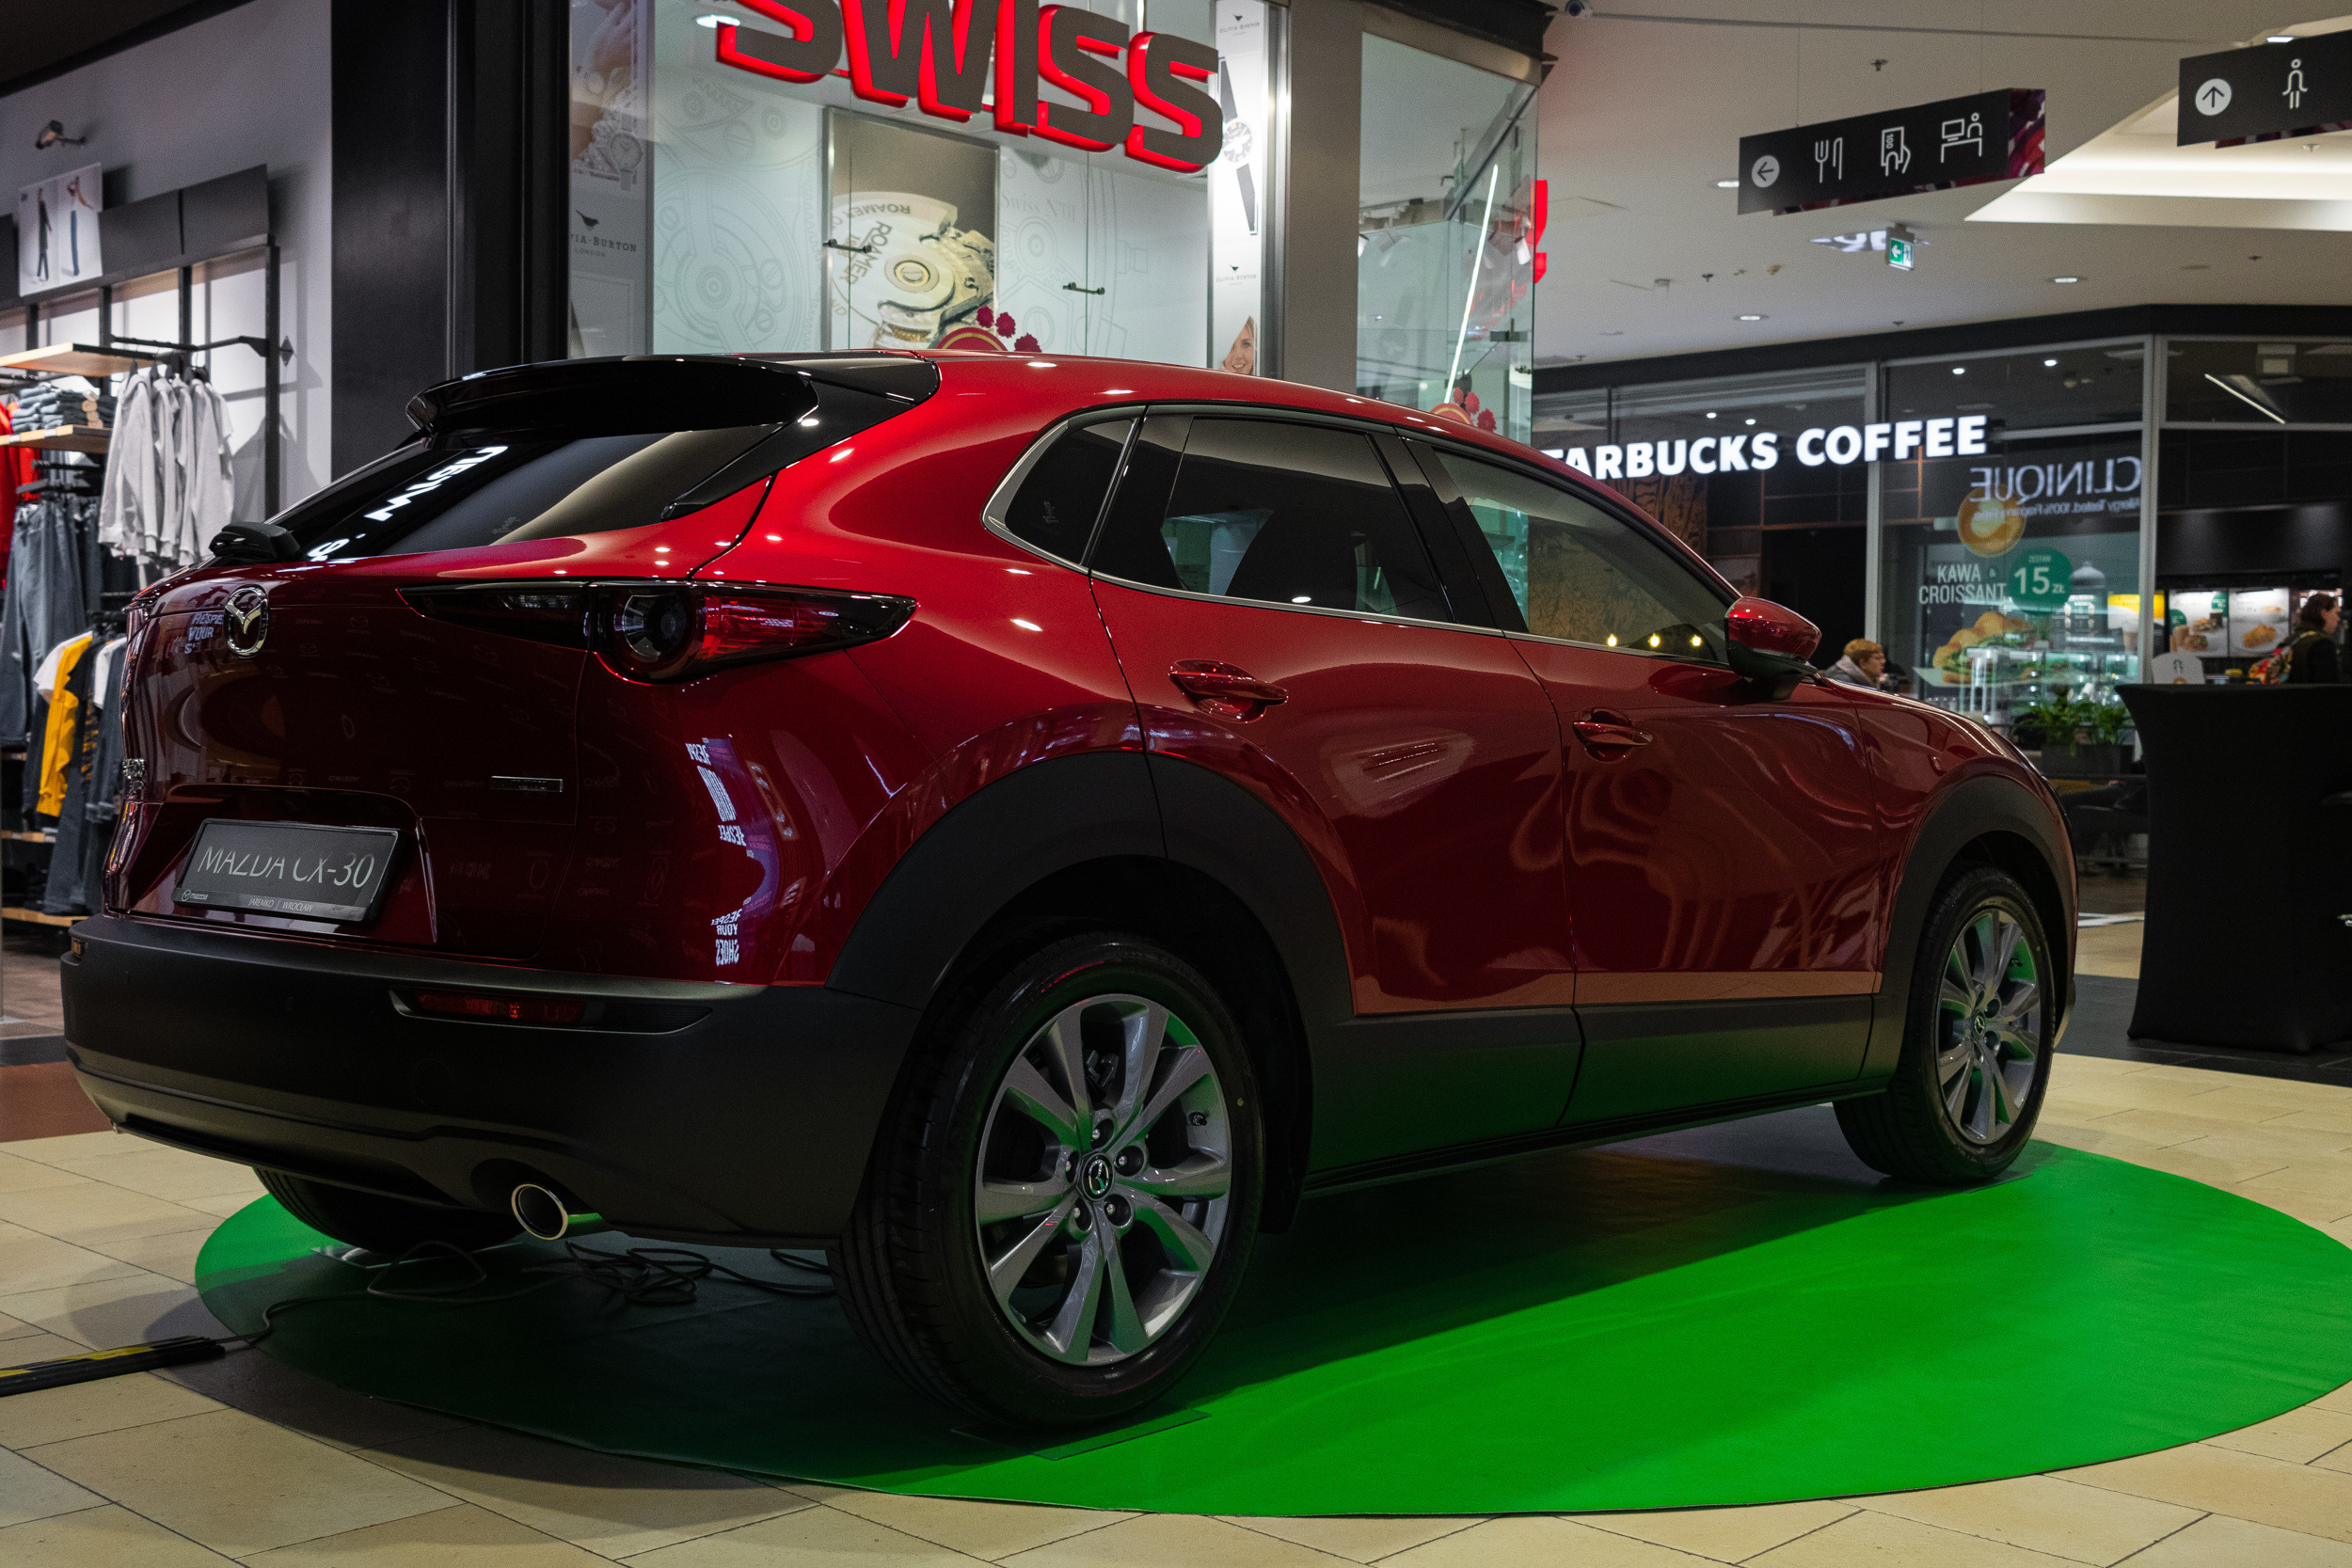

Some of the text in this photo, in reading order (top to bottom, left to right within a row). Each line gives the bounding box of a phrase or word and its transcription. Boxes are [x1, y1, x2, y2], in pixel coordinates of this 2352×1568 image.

[717, 0, 1222, 173] SWISS
[839, 220, 893, 285] ROAMER
[1539, 414, 1988, 481] ARBUCKS COFFEE
[1937, 563, 1981, 583] KAWA
[2014, 566, 2050, 594] 15
[1918, 582, 2007, 605] CROISSANT
[198, 846, 375, 889] MAZDA CX-30
[247, 897, 275, 908] JAREMKO
